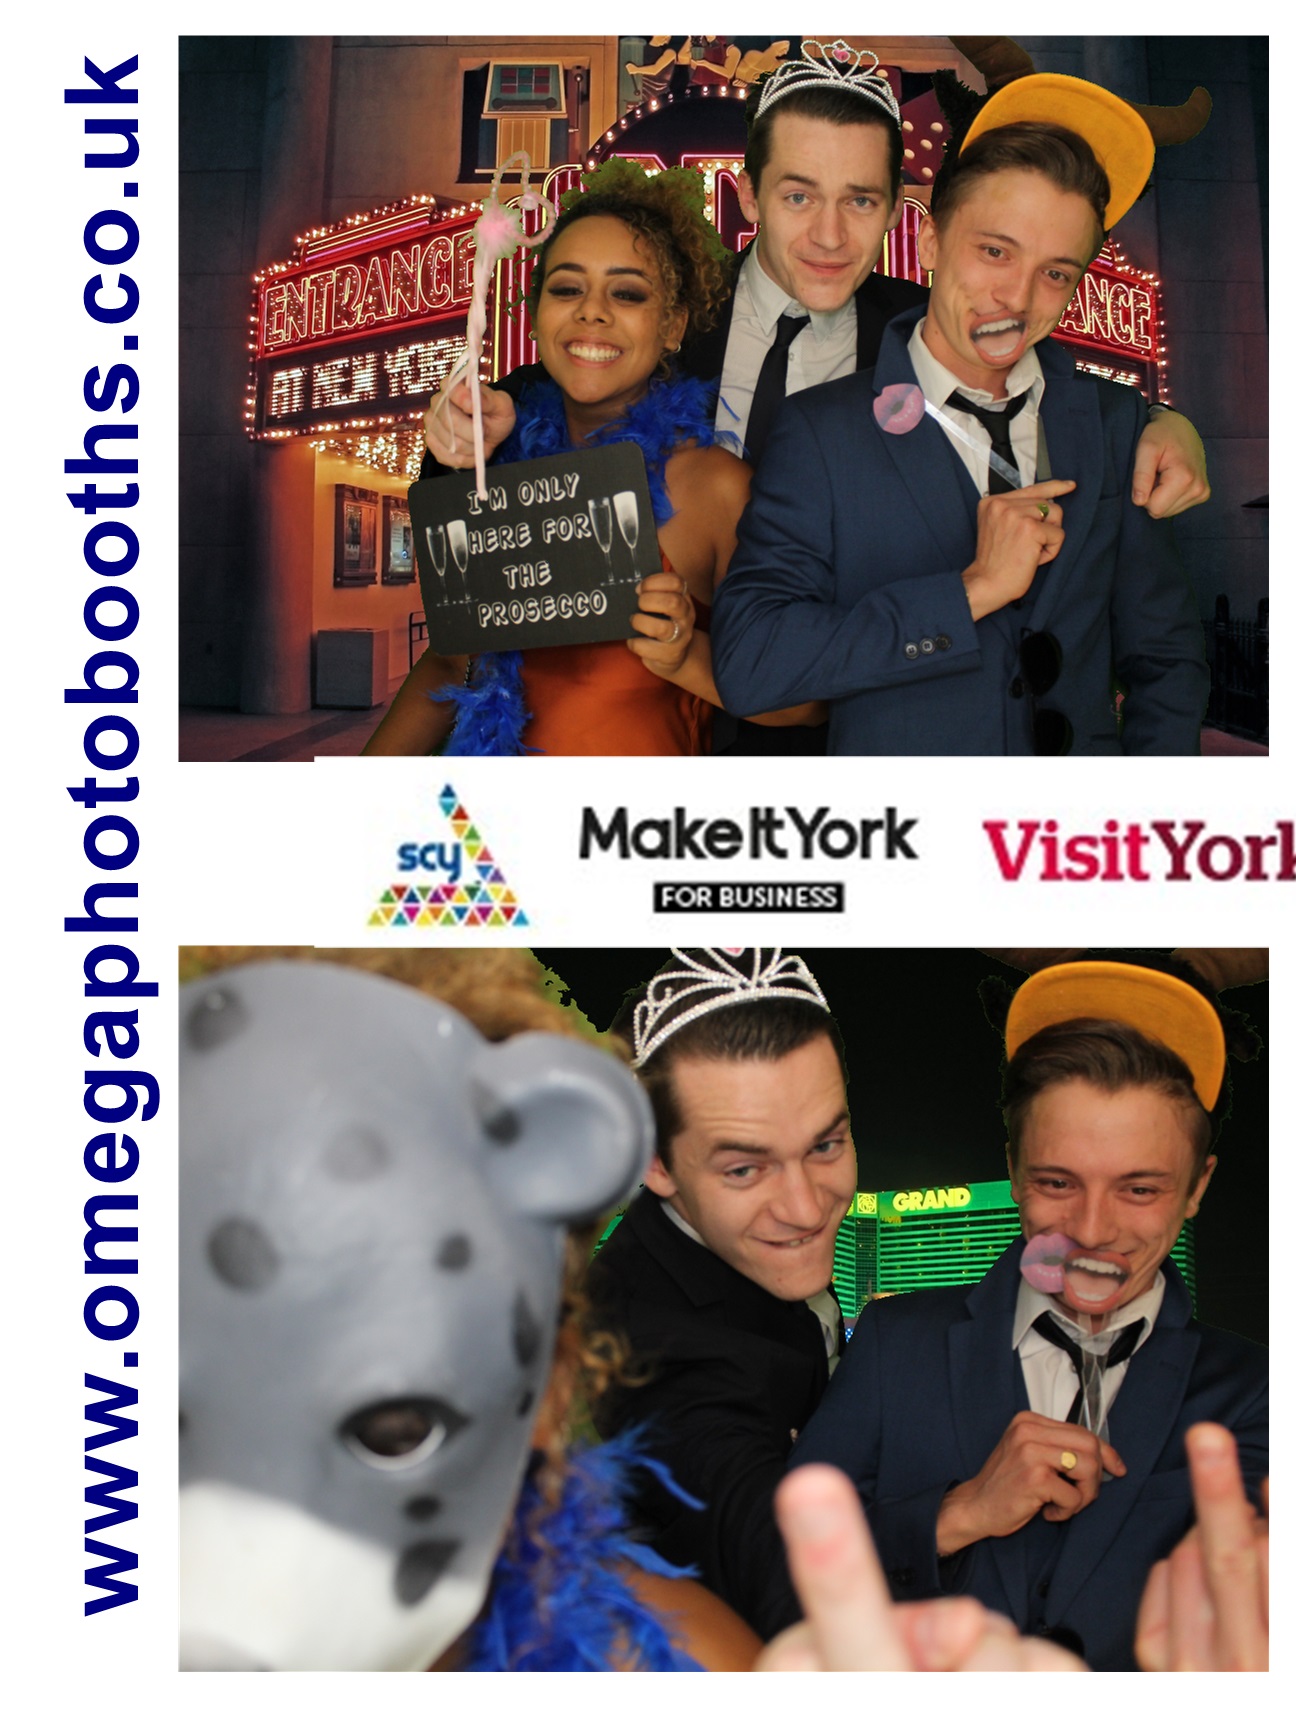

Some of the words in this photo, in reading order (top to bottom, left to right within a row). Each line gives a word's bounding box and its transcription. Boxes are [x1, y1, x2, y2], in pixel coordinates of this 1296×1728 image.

[263, 230, 477, 346] ENTRANCE
[1059, 273, 1152, 350] ANCE
[517, 472, 580, 506] ONLY
[468, 523, 533, 555] HERE
[541, 513, 593, 544] FOR
[502, 561, 552, 590] THE
[477, 589, 608, 628] PROSECCO
[892, 1187, 971, 1212] GRAND
